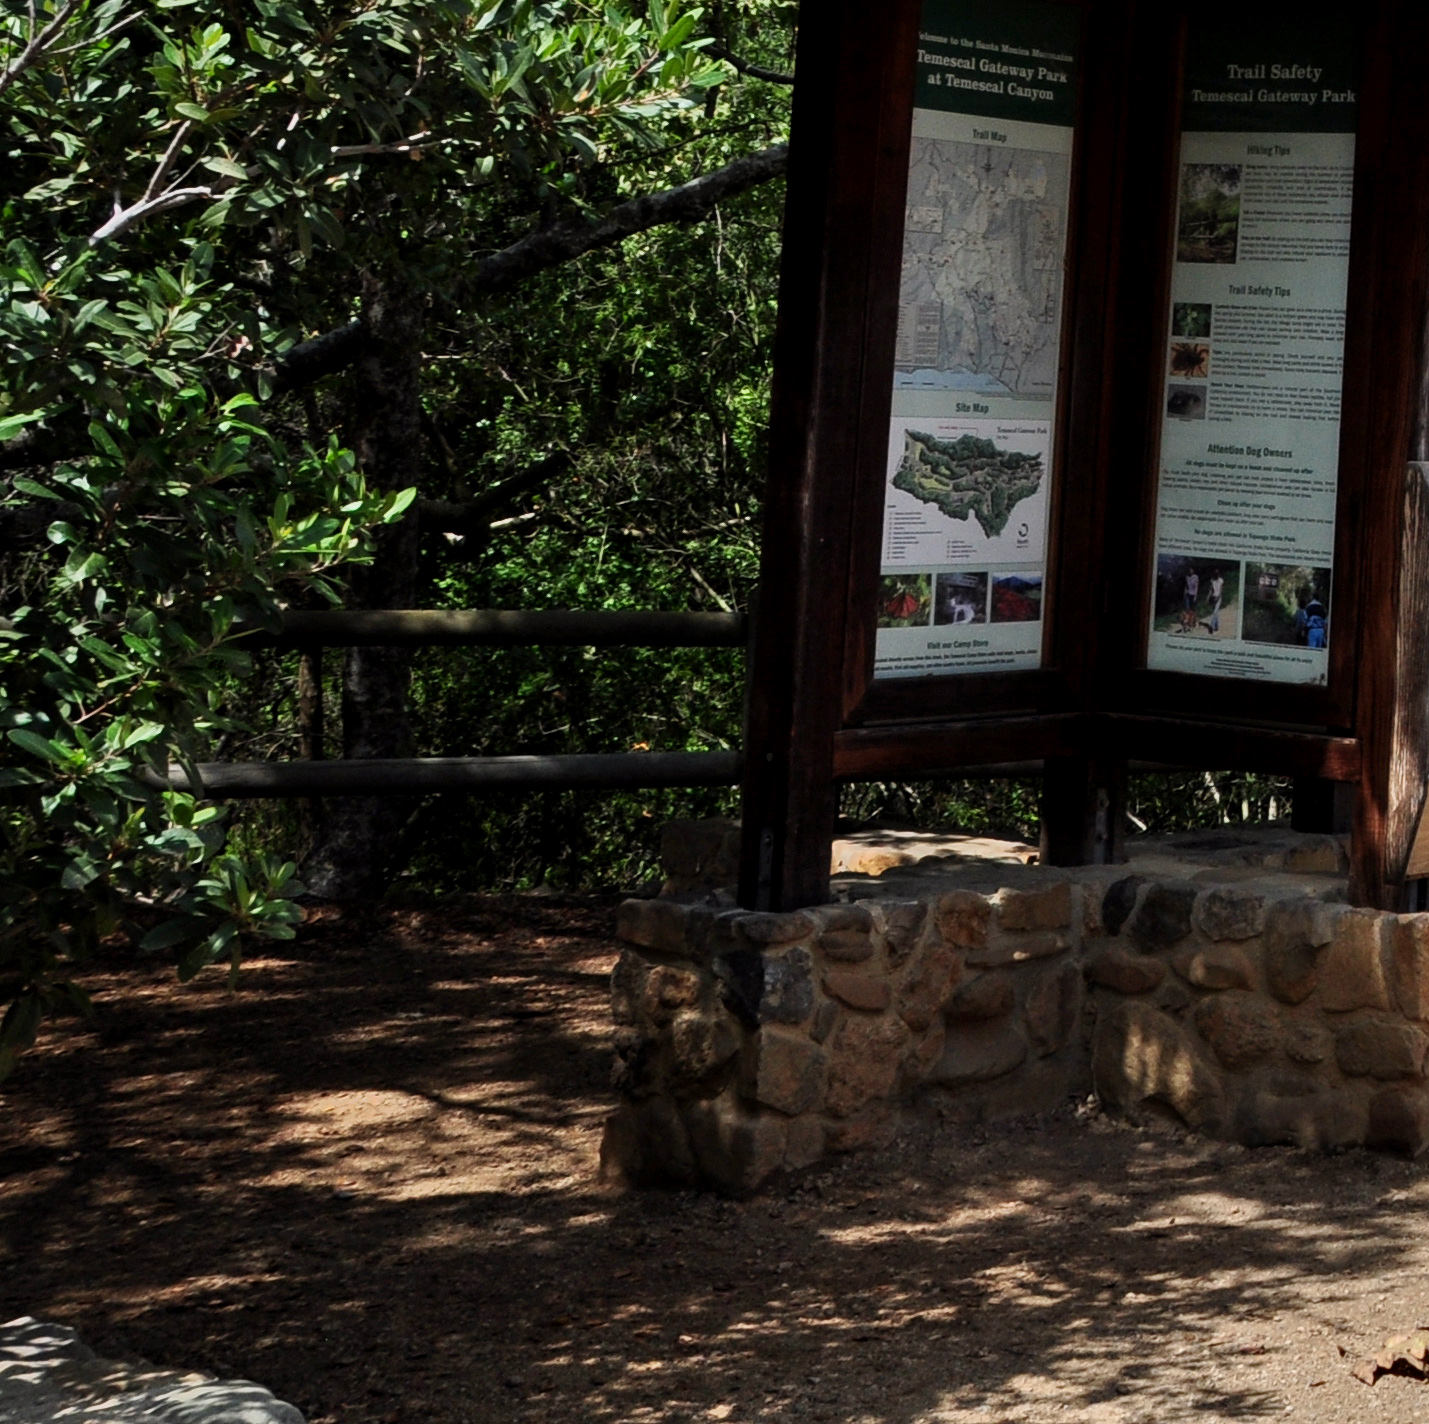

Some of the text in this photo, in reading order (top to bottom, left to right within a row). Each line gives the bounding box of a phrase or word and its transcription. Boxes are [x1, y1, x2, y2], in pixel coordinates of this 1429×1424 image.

[919, 32, 948, 44] elcome
[950, 36, 959, 46] to
[960, 37, 974, 48] the
[976, 39, 999, 52] Santa
[1001, 43, 1030, 56] Monica
[917, 49, 1068, 83] Temescal Gateway Park
[1227, 64, 1322, 83] Trail Safety
[927, 72, 1054, 101] at Temescal Canyon
[1191, 89, 1356, 105] Temescal Gateway Park
[973, 129, 1007, 143] Trail Map
[1247, 145, 1291, 157] Hiking Tips
[1228, 285, 1291, 297] Trail Safety Tips
[956, 402, 989, 414] Site Map
[1207, 443, 1293, 458] Attention Dog Owners
[953, 640, 971, 649] Camp
[972, 639, 989, 647] Store
